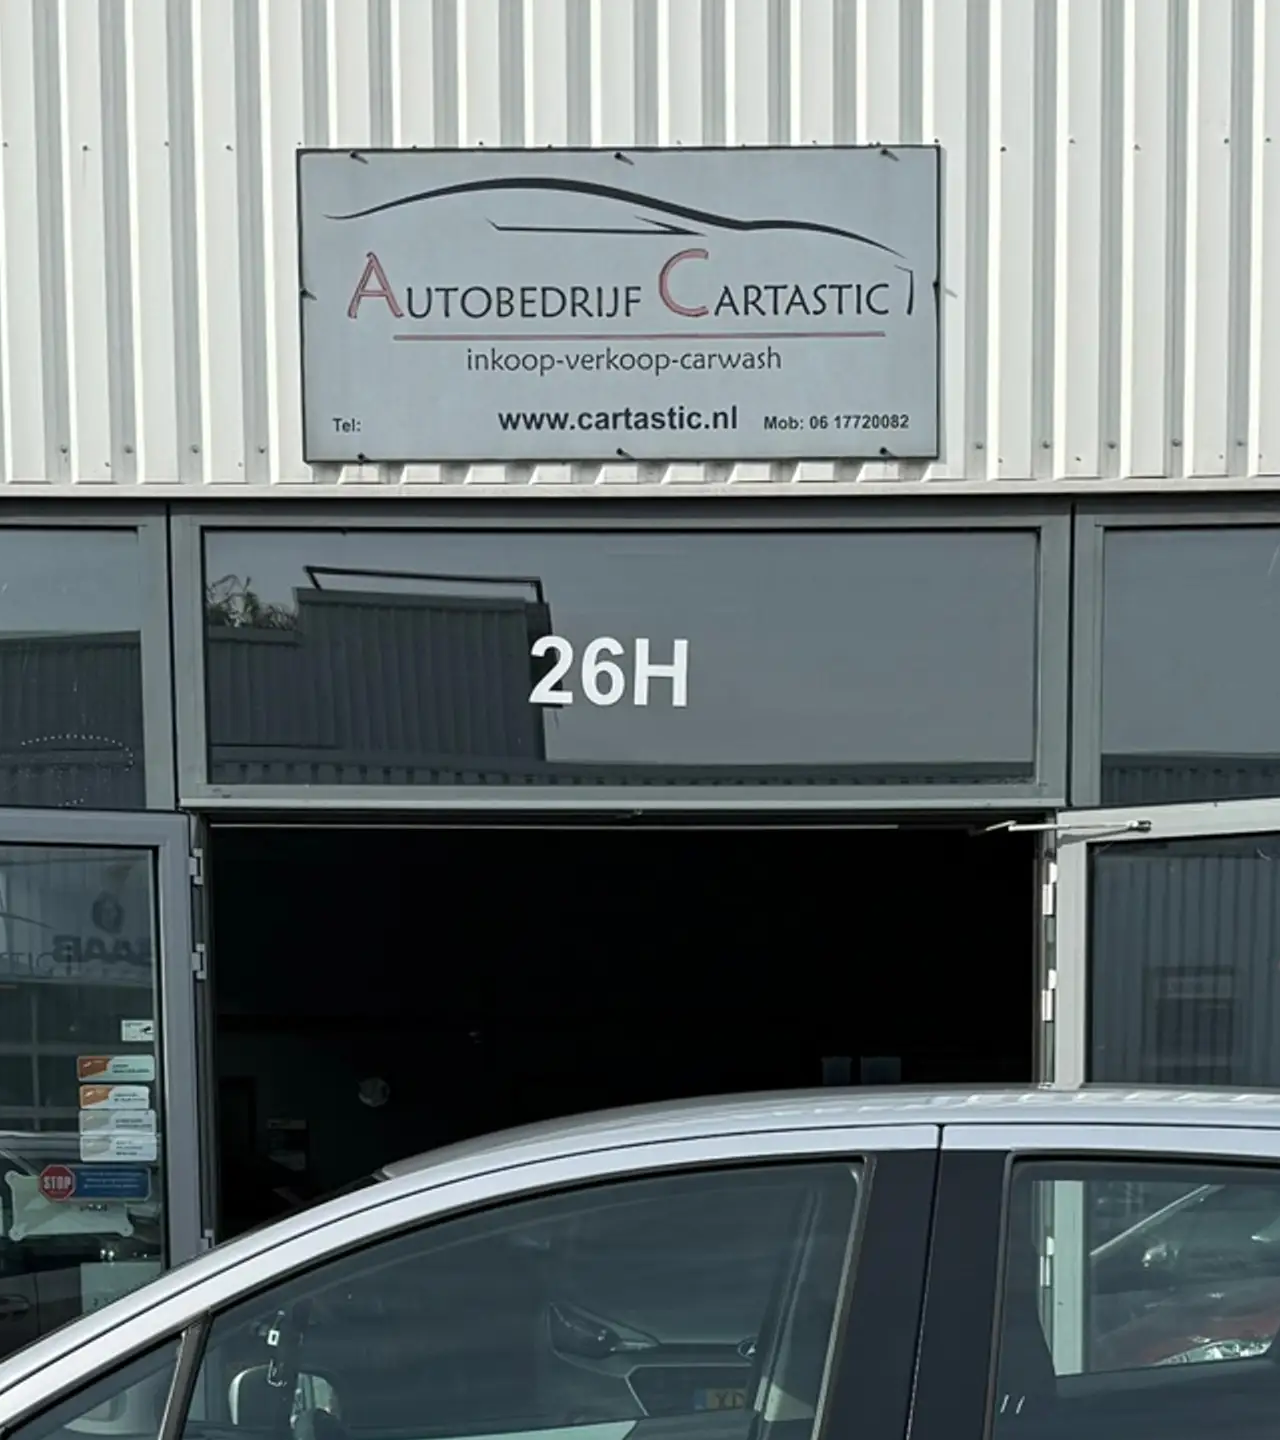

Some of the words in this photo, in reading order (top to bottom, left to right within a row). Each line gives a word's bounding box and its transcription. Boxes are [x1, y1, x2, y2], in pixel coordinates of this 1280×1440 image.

[467, 347, 782, 376] inkoop-verkoop-carwash
[332, 418, 361, 433] Tel:
[498, 405, 738, 430] www.cartastic.nl
[763, 415, 804, 430] Mob:
[809, 415, 829, 430] 06
[834, 414, 910, 430] 17720082
[528, 635, 689, 708] 26H
[43, 1175, 72, 1190] STOP
